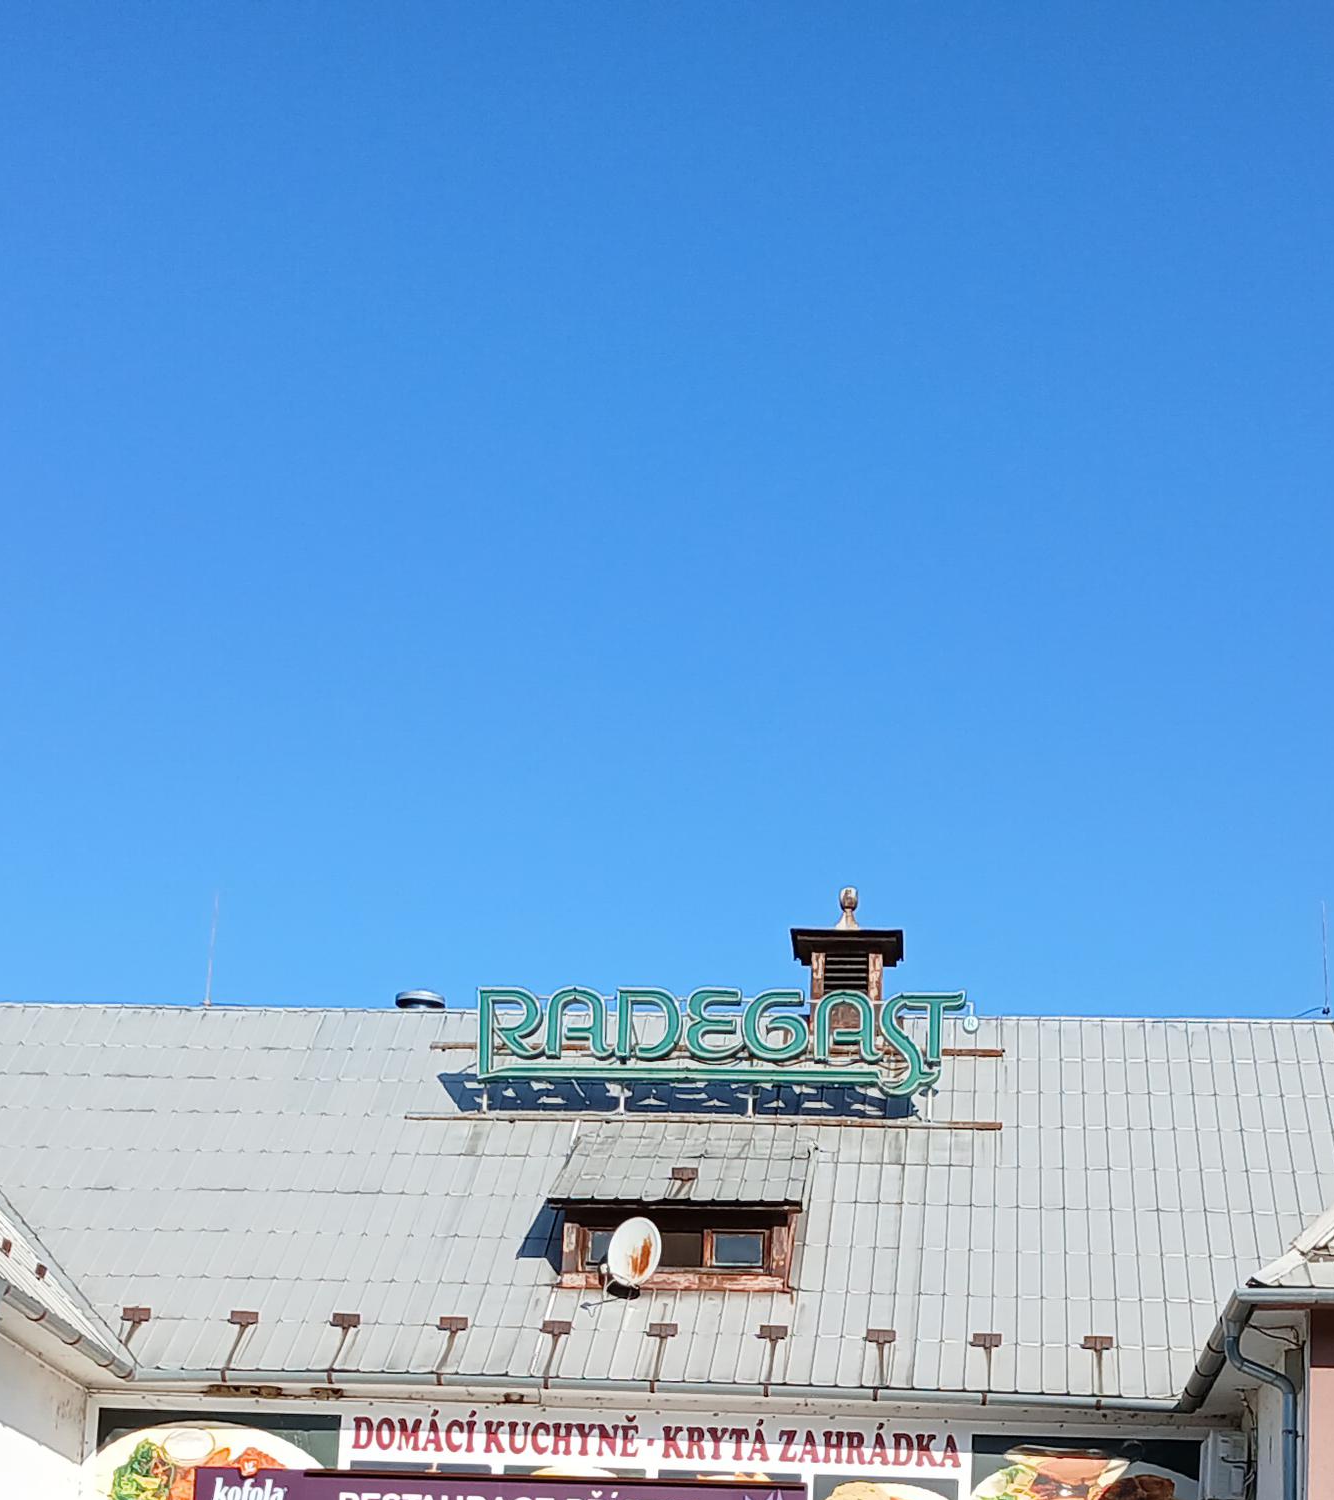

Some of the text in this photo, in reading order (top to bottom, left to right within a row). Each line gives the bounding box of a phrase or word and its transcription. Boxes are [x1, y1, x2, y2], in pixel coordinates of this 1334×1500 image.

[476, 985, 967, 1097] RADEGAST
[352, 1409, 477, 1452] DOMÁCÍ
[483, 1414, 639, 1457] KUCHYNĚ
[662, 1418, 770, 1461] KRYTÁ
[778, 1422, 961, 1467] ZAHRÁDKA
